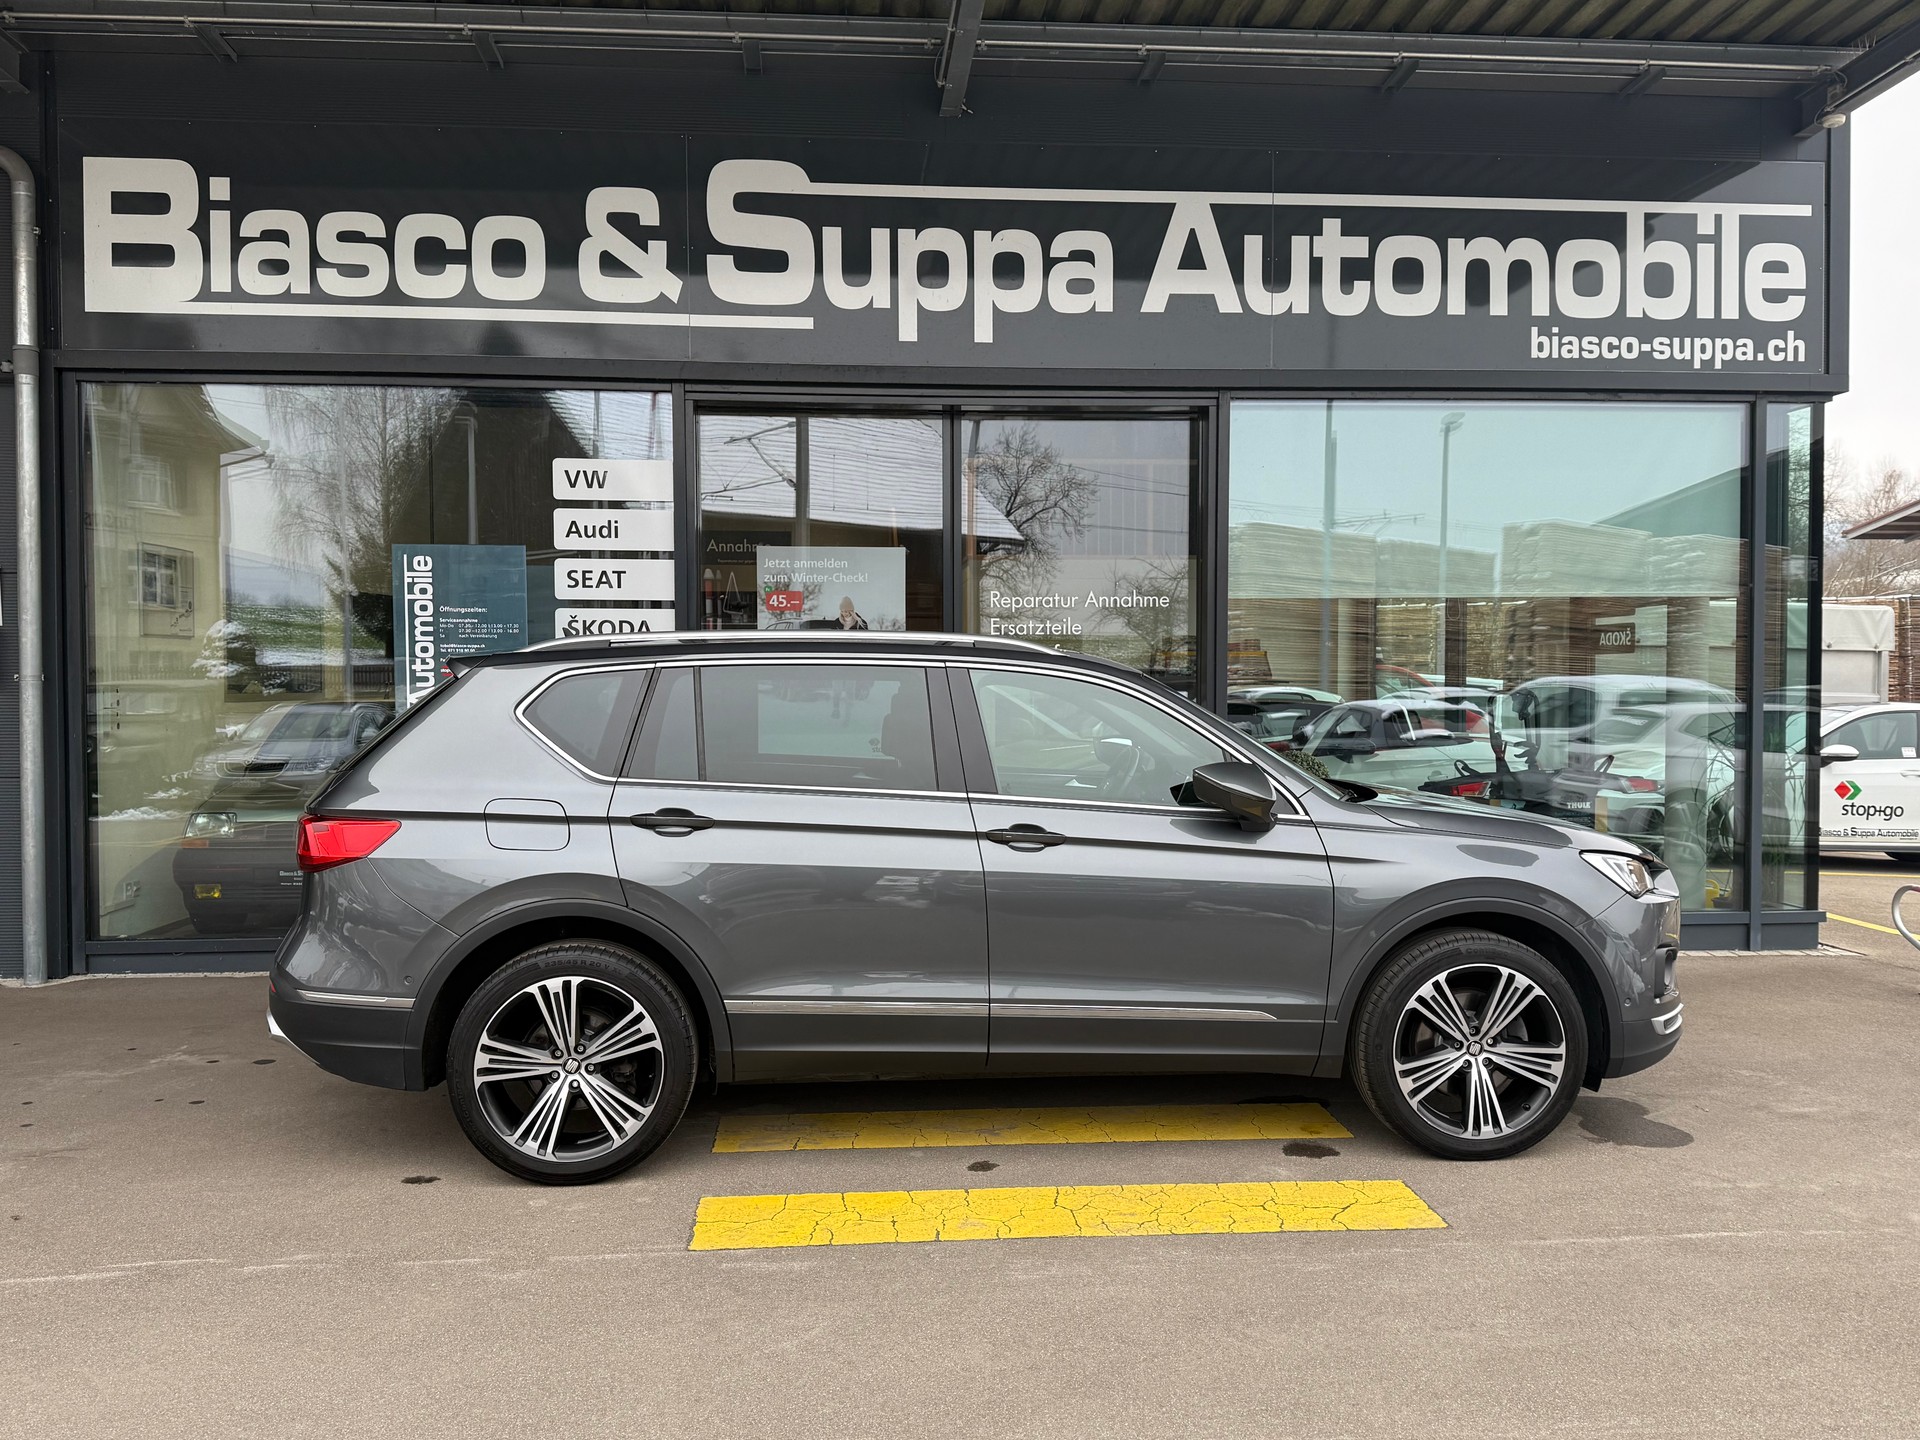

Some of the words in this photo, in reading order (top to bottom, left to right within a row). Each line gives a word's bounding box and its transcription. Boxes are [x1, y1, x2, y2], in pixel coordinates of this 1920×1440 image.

[83, 156, 546, 312] Biasco
[578, 186, 683, 304] &
[706, 158, 1114, 343] Suppa
[1140, 193, 1807, 322] Automobile
[1530, 326, 1806, 370] biasco-suppa.ch
[564, 469, 608, 489] VW
[565, 519, 619, 539] Audi
[706, 537, 772, 553] Annah
[763, 558, 791, 569] Jetzt
[793, 557, 848, 569] anmelden
[566, 570, 627, 589] SEAT
[763, 574, 789, 583] zum
[790, 572, 869, 583] Winter-Check!
[989, 590, 1079, 613] Reparatur
[1084, 589, 1170, 608] Annahme
[989, 616, 1082, 636] Ersatzteile
[1566, 801, 1592, 809] THULE
[1841, 802, 1905, 821] stop+go
[589, 960, 602, 968] 20
